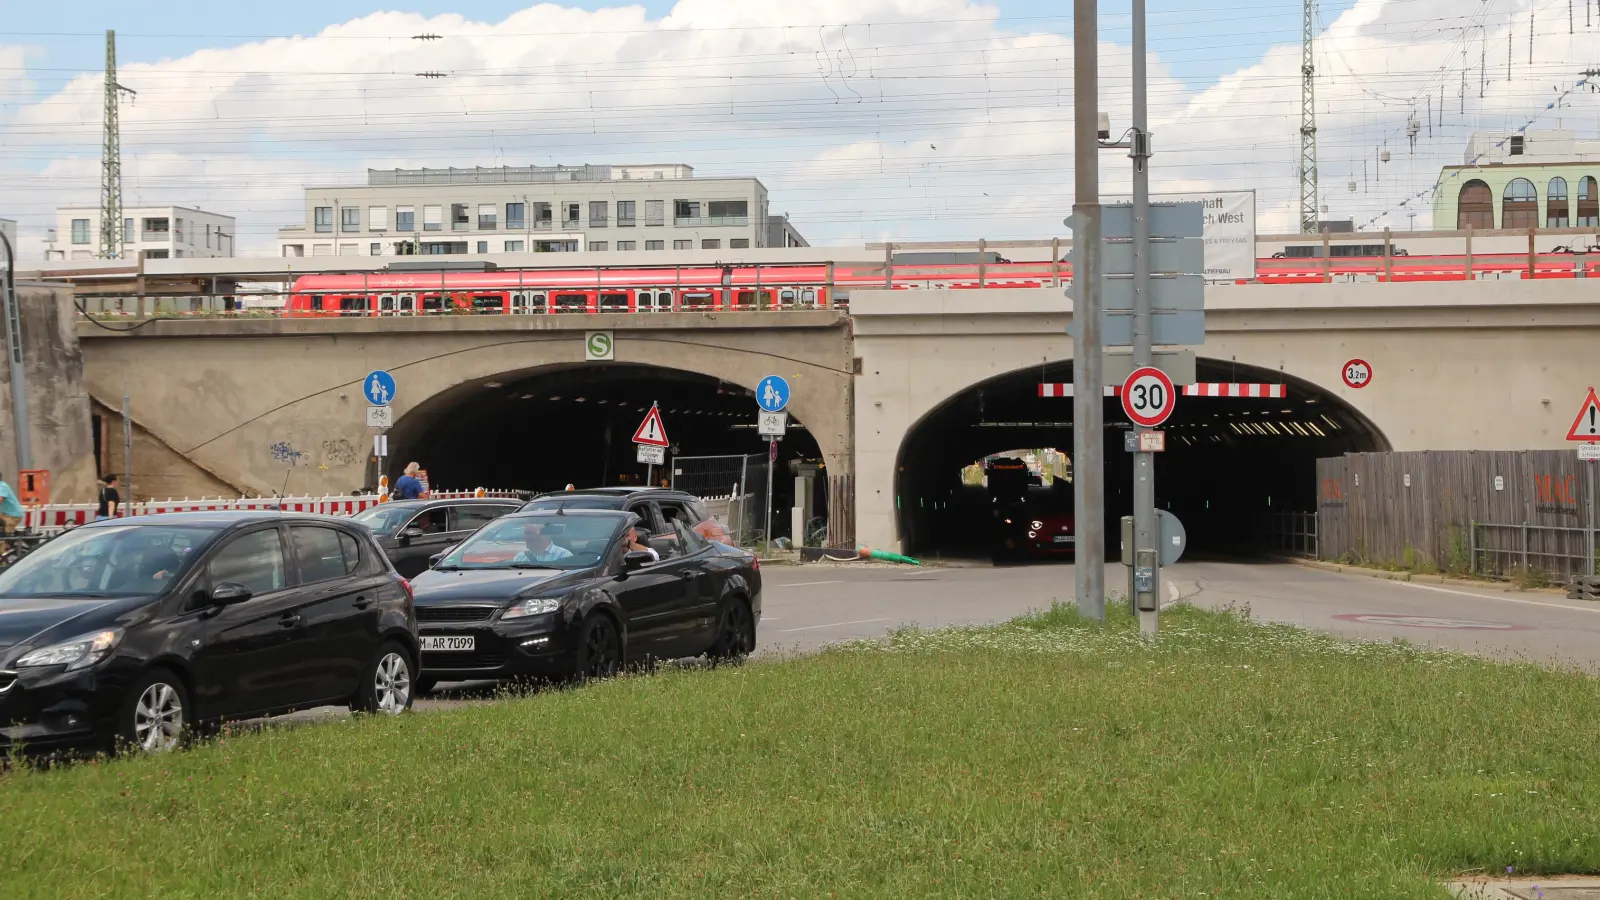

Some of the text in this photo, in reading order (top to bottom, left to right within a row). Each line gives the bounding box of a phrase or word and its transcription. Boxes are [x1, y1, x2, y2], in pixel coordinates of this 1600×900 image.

[1218, 212, 1244, 224] West
[591, 334, 608, 356] S
[1133, 384, 1163, 410] 30
[1535, 474, 1577, 504] MAC
[420, 637, 474, 649] M AR 7099
